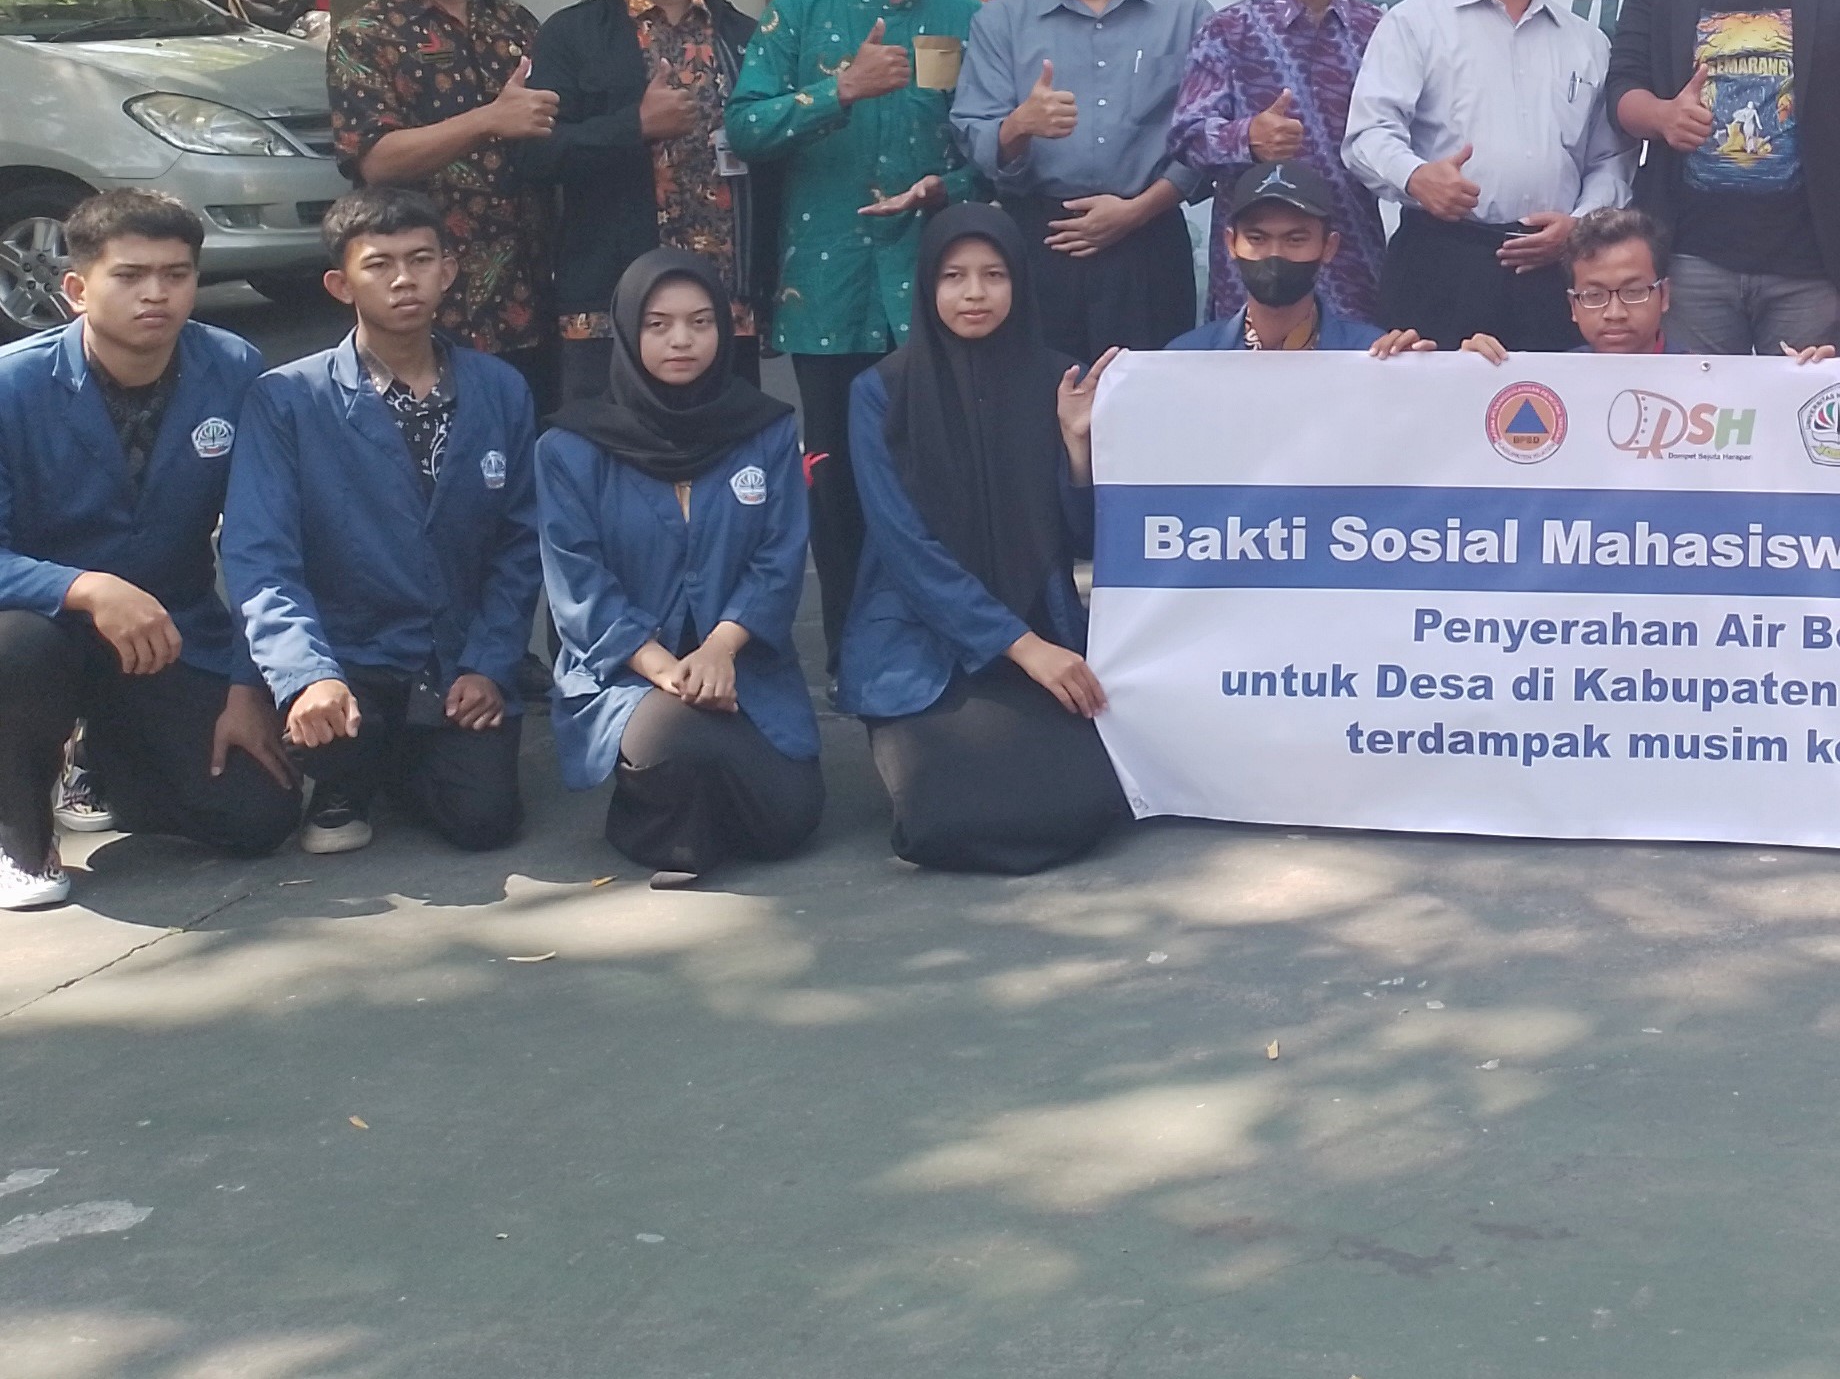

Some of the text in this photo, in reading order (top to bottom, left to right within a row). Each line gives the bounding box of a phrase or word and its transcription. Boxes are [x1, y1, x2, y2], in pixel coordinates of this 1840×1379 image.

[1143, 515, 1308, 561] Bakti
[1329, 516, 1520, 564] Sosial
[1413, 608, 1699, 653] Penyerahan
[1715, 613, 1787, 648] Air
[1221, 663, 1359, 697] untuk
[1376, 664, 1495, 701] Desa
[1511, 667, 1555, 702] di
[1573, 667, 1838, 712] Kabupaten
[1346, 721, 1612, 767] terdampak
[1628, 726, 1788, 762] musim
